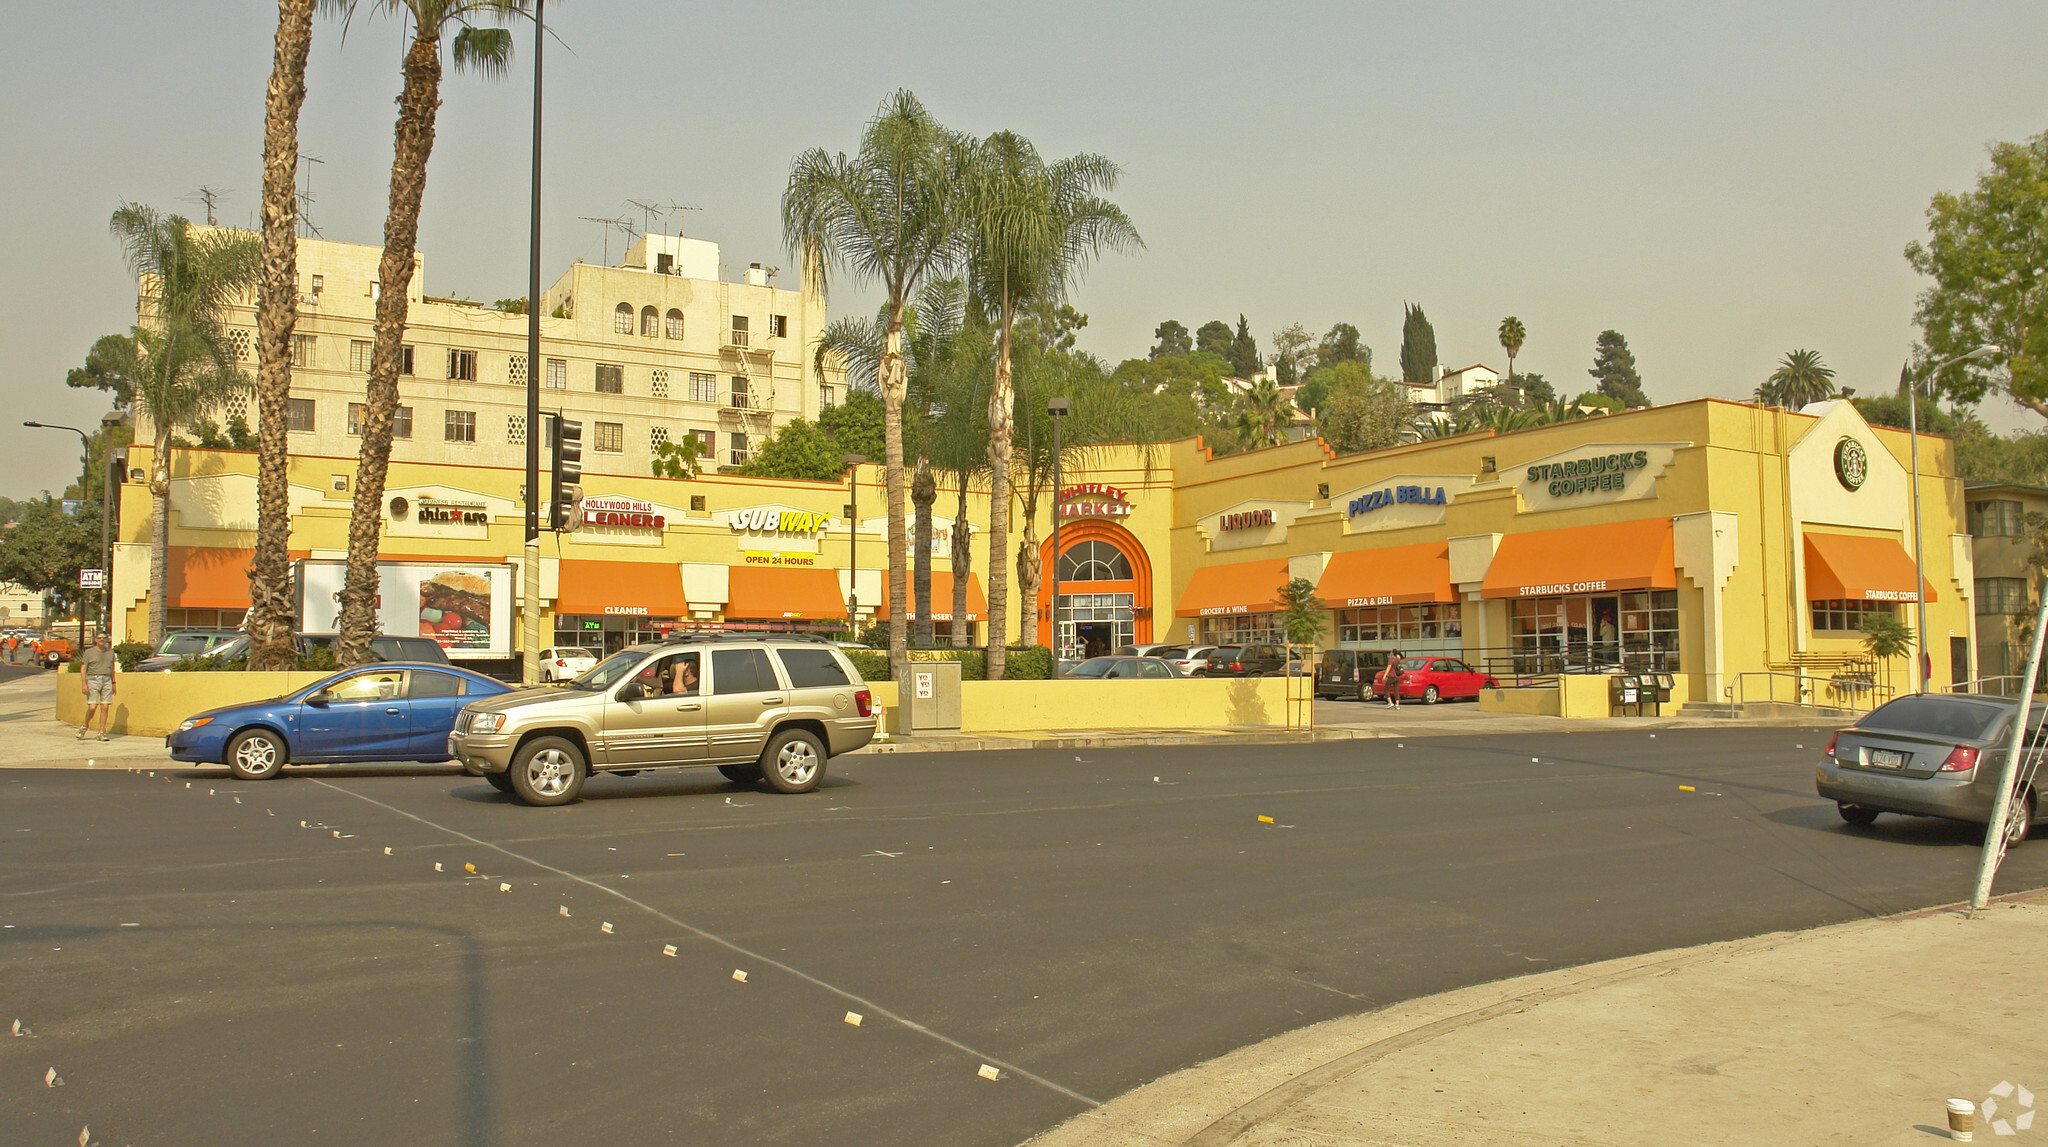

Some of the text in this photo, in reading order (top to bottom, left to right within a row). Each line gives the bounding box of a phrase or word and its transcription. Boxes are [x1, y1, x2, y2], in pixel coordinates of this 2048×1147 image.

[1527, 450, 1647, 482] STARBUCKS
[1548, 472, 1624, 497] COFFEE
[585, 500, 652, 512] HOLLYWOOD HILLS
[1349, 485, 1447, 517] PIZZA BELLA
[583, 511, 665, 529] LEANERS
[729, 510, 832, 533] SUBWAY
[1219, 509, 1273, 531] LIQUOR
[745, 556, 814, 566] OPEN 24 HOURS
[82, 572, 101, 581] ATM
[1519, 580, 1607, 596] STARBUCKS COFFEE
[1347, 595, 1393, 607] PIZZA & DELI
[1865, 589, 1919, 601] STARBUCKS COFFE
[604, 606, 648, 615] CLEANERS
[905, 612, 917, 620] TH
[1200, 605, 1248, 616] GROCERY & WINE
